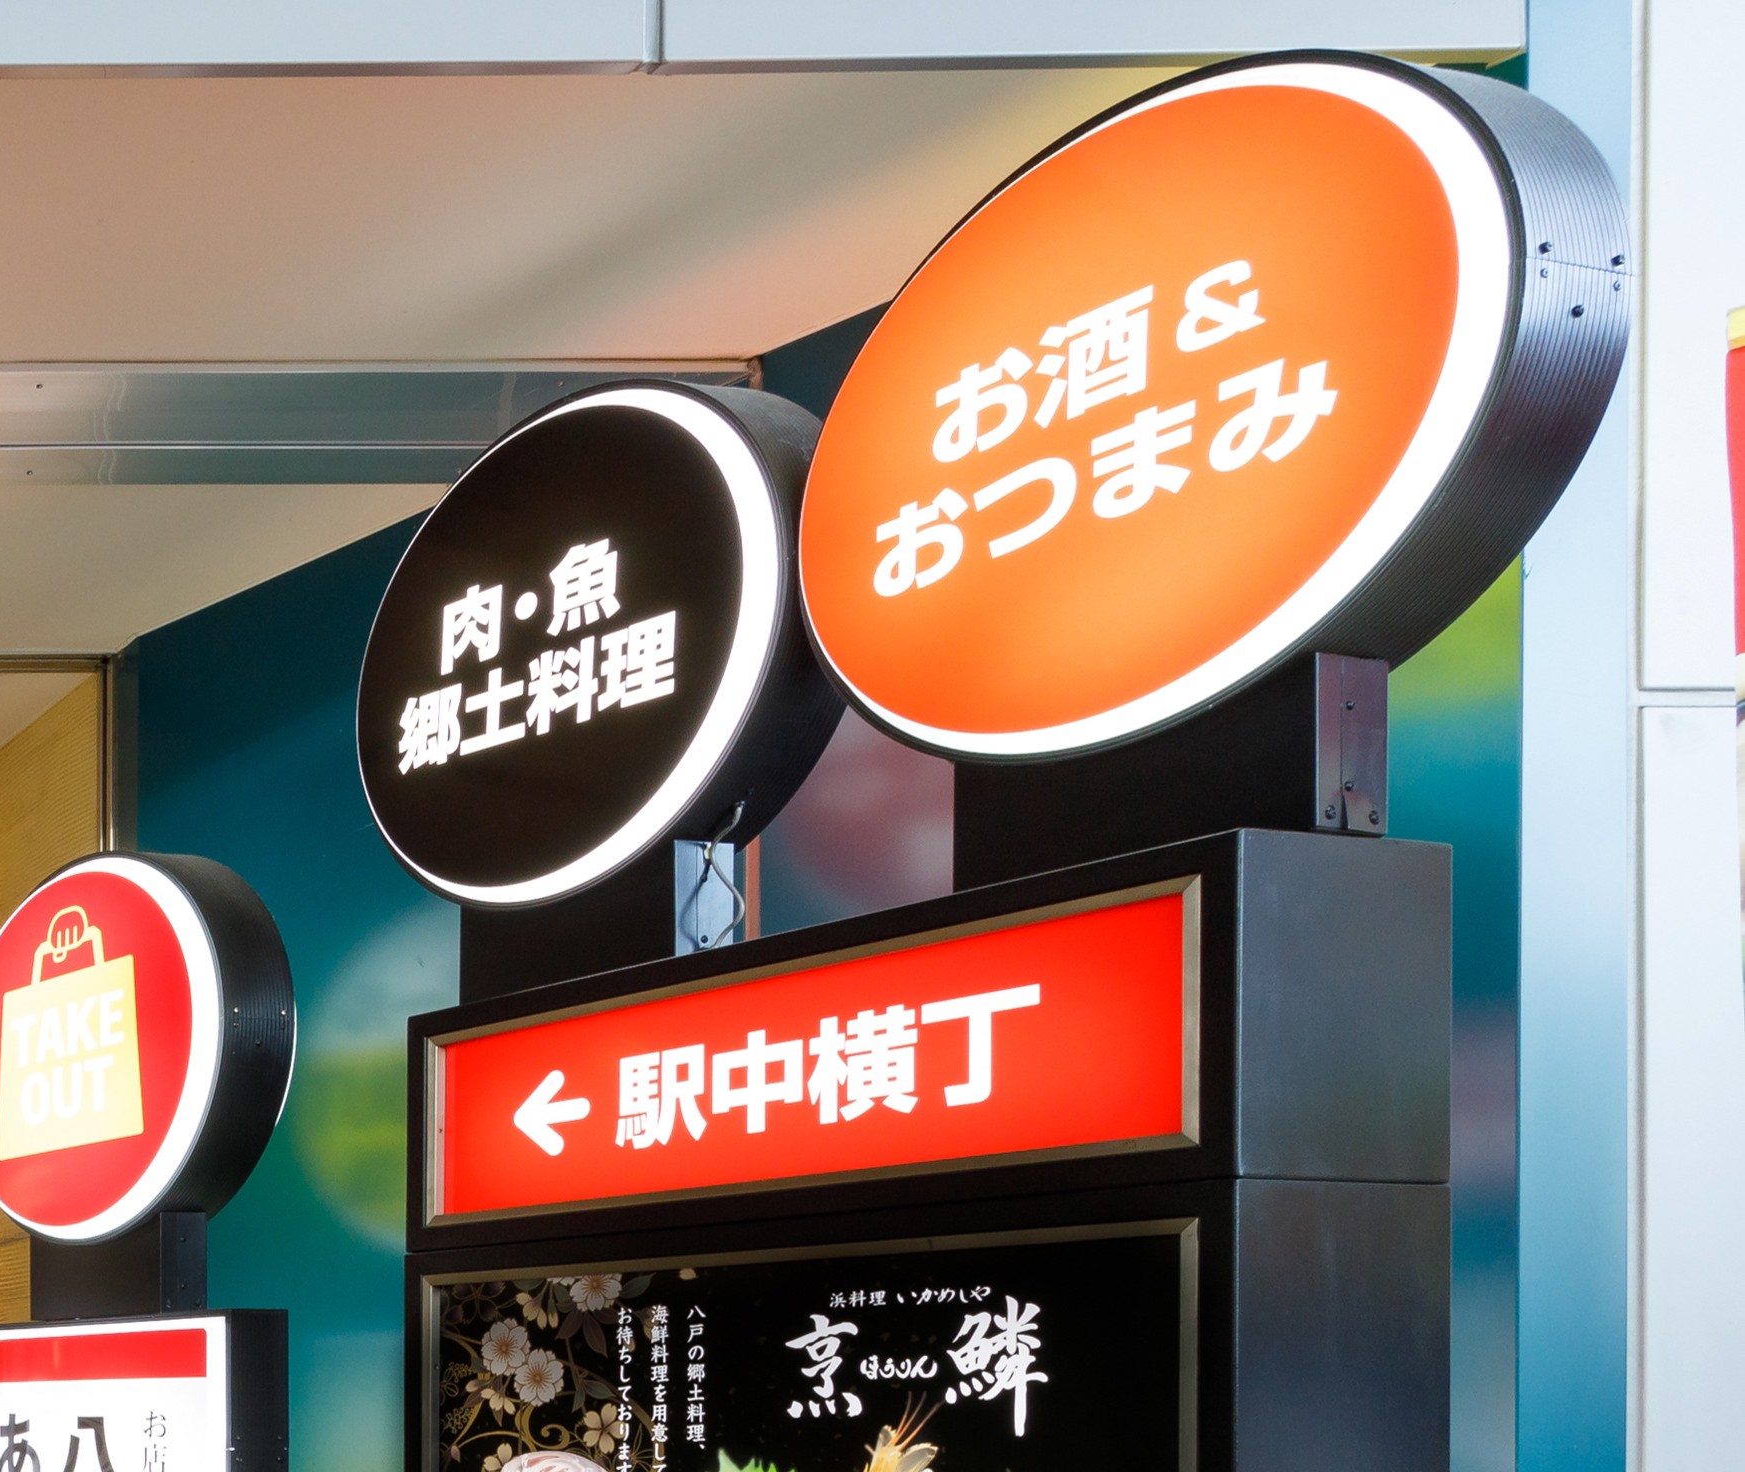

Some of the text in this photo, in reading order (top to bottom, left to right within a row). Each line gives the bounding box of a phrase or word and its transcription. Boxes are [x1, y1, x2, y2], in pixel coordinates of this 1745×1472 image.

[932, 285, 1154, 463] お酒
[871, 357, 1339, 598] おつまみ
[440, 538, 621, 676] 肉・魚
[398, 611, 678, 777] 郷土料理
[10, 988, 124, 1070] TAKE
[21, 1056, 113, 1125] OUT
[615, 984, 1040, 1149] 駅中横丁
[829, 1285, 991, 1308] 浜料理 いかめしや
[860, 1354, 938, 1380] ほうりん
[686, 1305, 706, 1450] 八戸の郷土料理、
